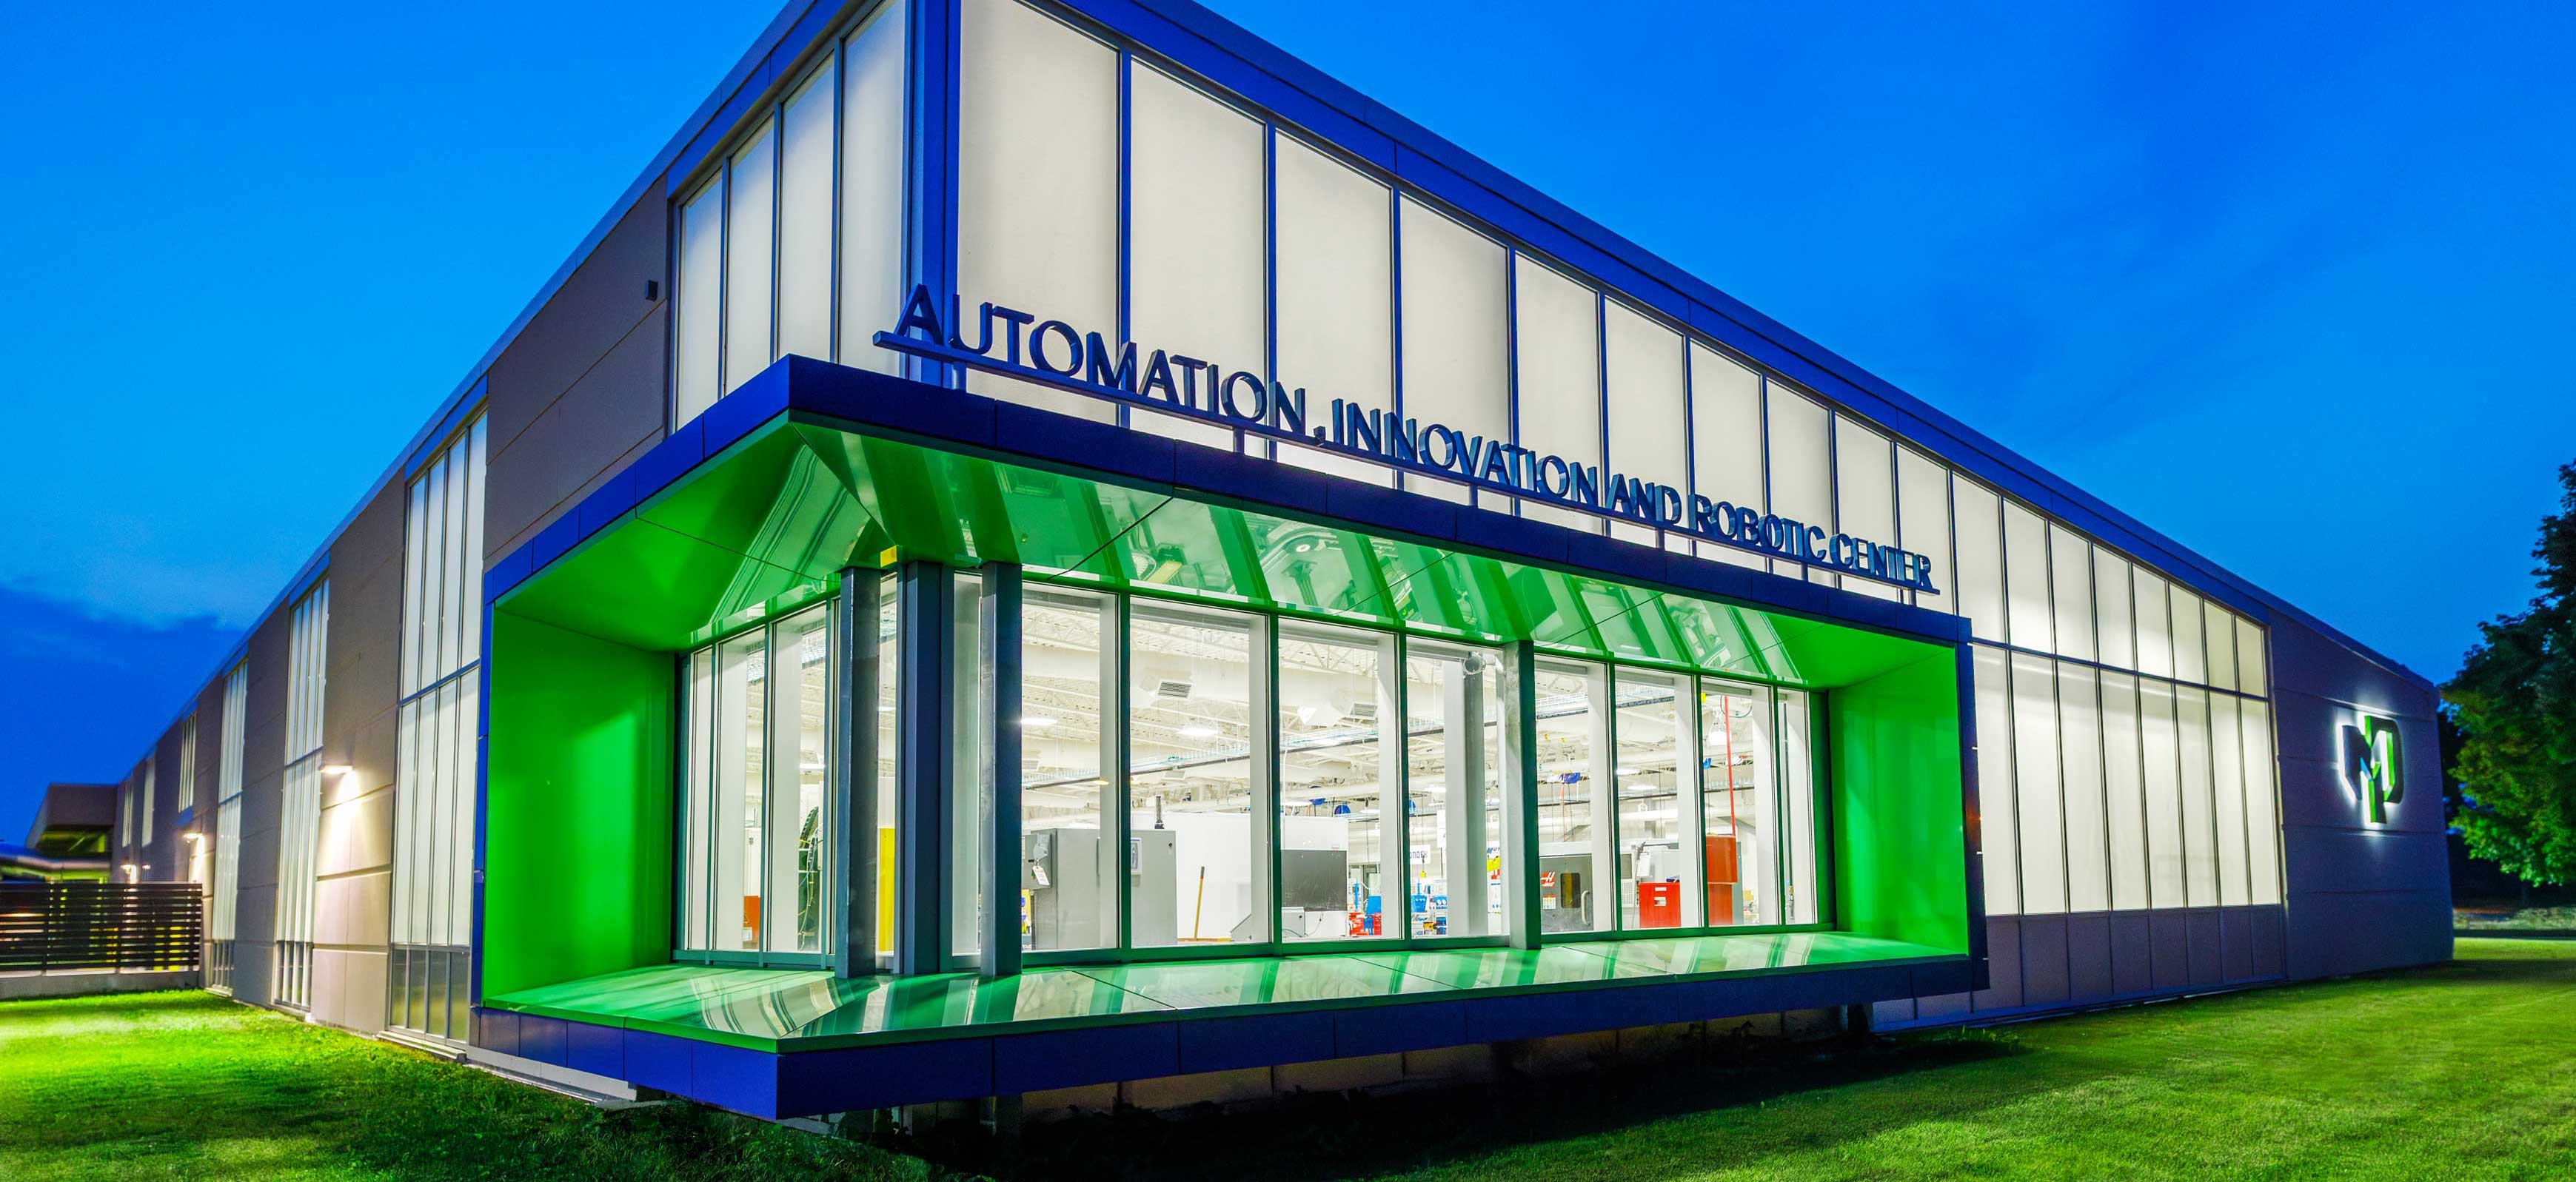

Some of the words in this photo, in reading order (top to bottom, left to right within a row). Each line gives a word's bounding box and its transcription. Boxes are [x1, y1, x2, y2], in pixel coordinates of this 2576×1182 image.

[893, 283, 1326, 446] AUTOMATION,
[1332, 398, 1599, 505] INNOVATION
[1605, 473, 1682, 525] AND
[1688, 493, 1827, 561] ROBOTIC
[1829, 533, 1934, 589] CENTER
